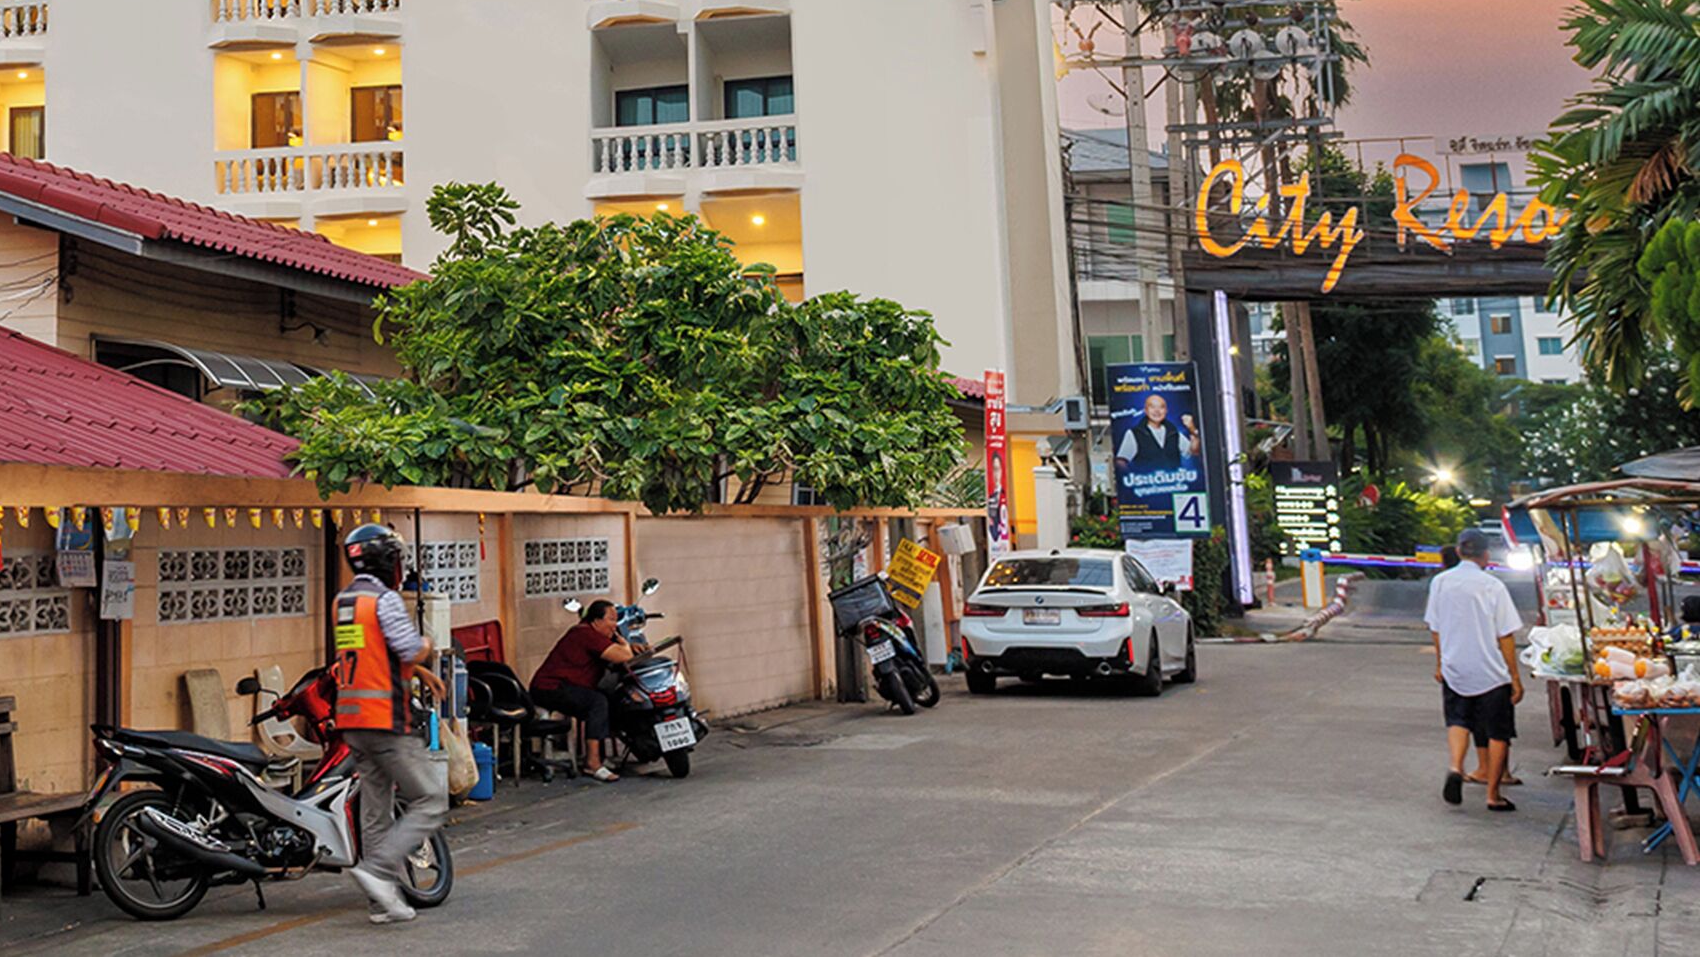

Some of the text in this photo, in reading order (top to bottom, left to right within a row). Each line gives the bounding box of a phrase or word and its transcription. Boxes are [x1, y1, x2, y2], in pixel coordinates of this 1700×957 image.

[1197, 153, 1572, 292] City Reso
[1123, 467, 1198, 487] ประเดิมชัย
[1178, 496, 1205, 528] 4
